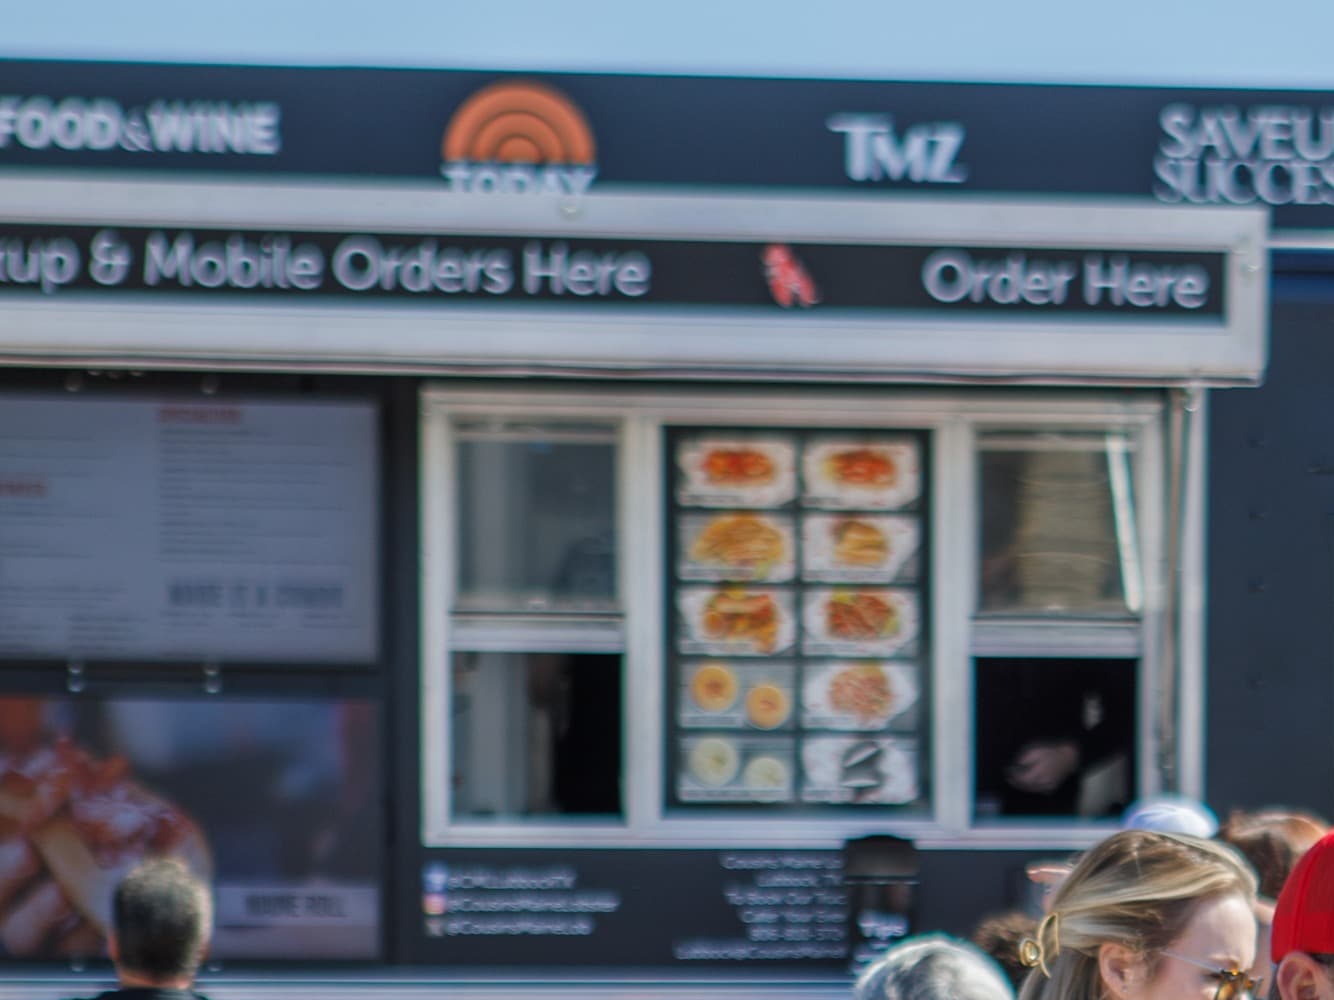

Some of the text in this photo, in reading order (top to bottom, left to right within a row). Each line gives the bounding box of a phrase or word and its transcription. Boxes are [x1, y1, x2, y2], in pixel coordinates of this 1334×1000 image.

[441, 164, 598, 195] TODAY
[827, 112, 969, 183] TMZ
[89, 229, 132, 285] &
[143, 230, 324, 290] Mobile
[332, 233, 514, 296] Orders
[522, 238, 652, 297] Here
[921, 247, 1209, 309] Order Here
